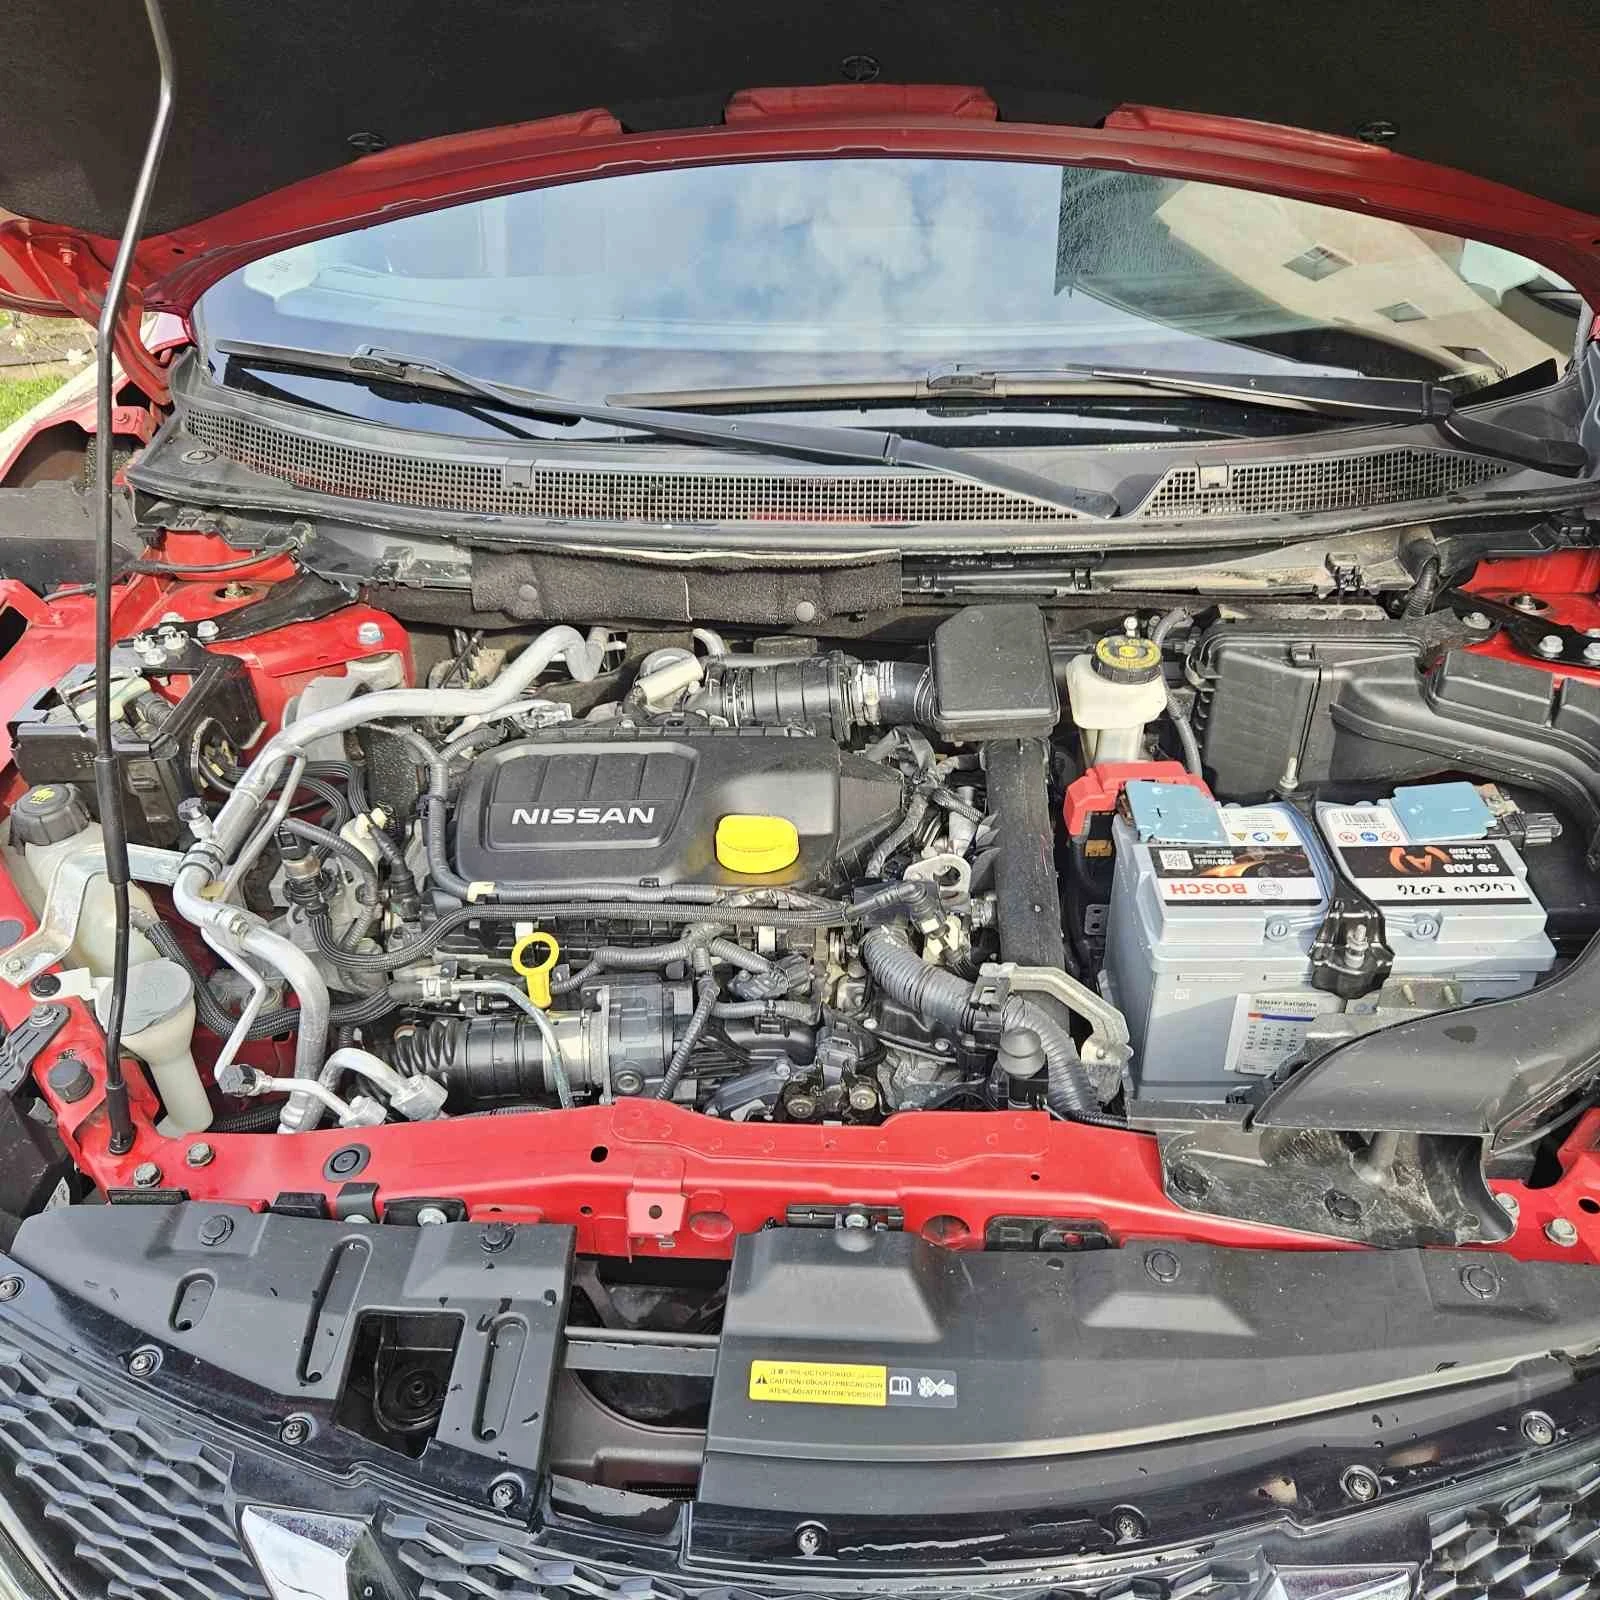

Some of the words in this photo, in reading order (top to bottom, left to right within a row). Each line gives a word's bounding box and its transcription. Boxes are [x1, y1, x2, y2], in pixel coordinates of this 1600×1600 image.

[511, 807, 655, 825] NISSAN
[1170, 883, 1248, 895] BOSCH
[1453, 882, 1517, 893] LUGLIO
